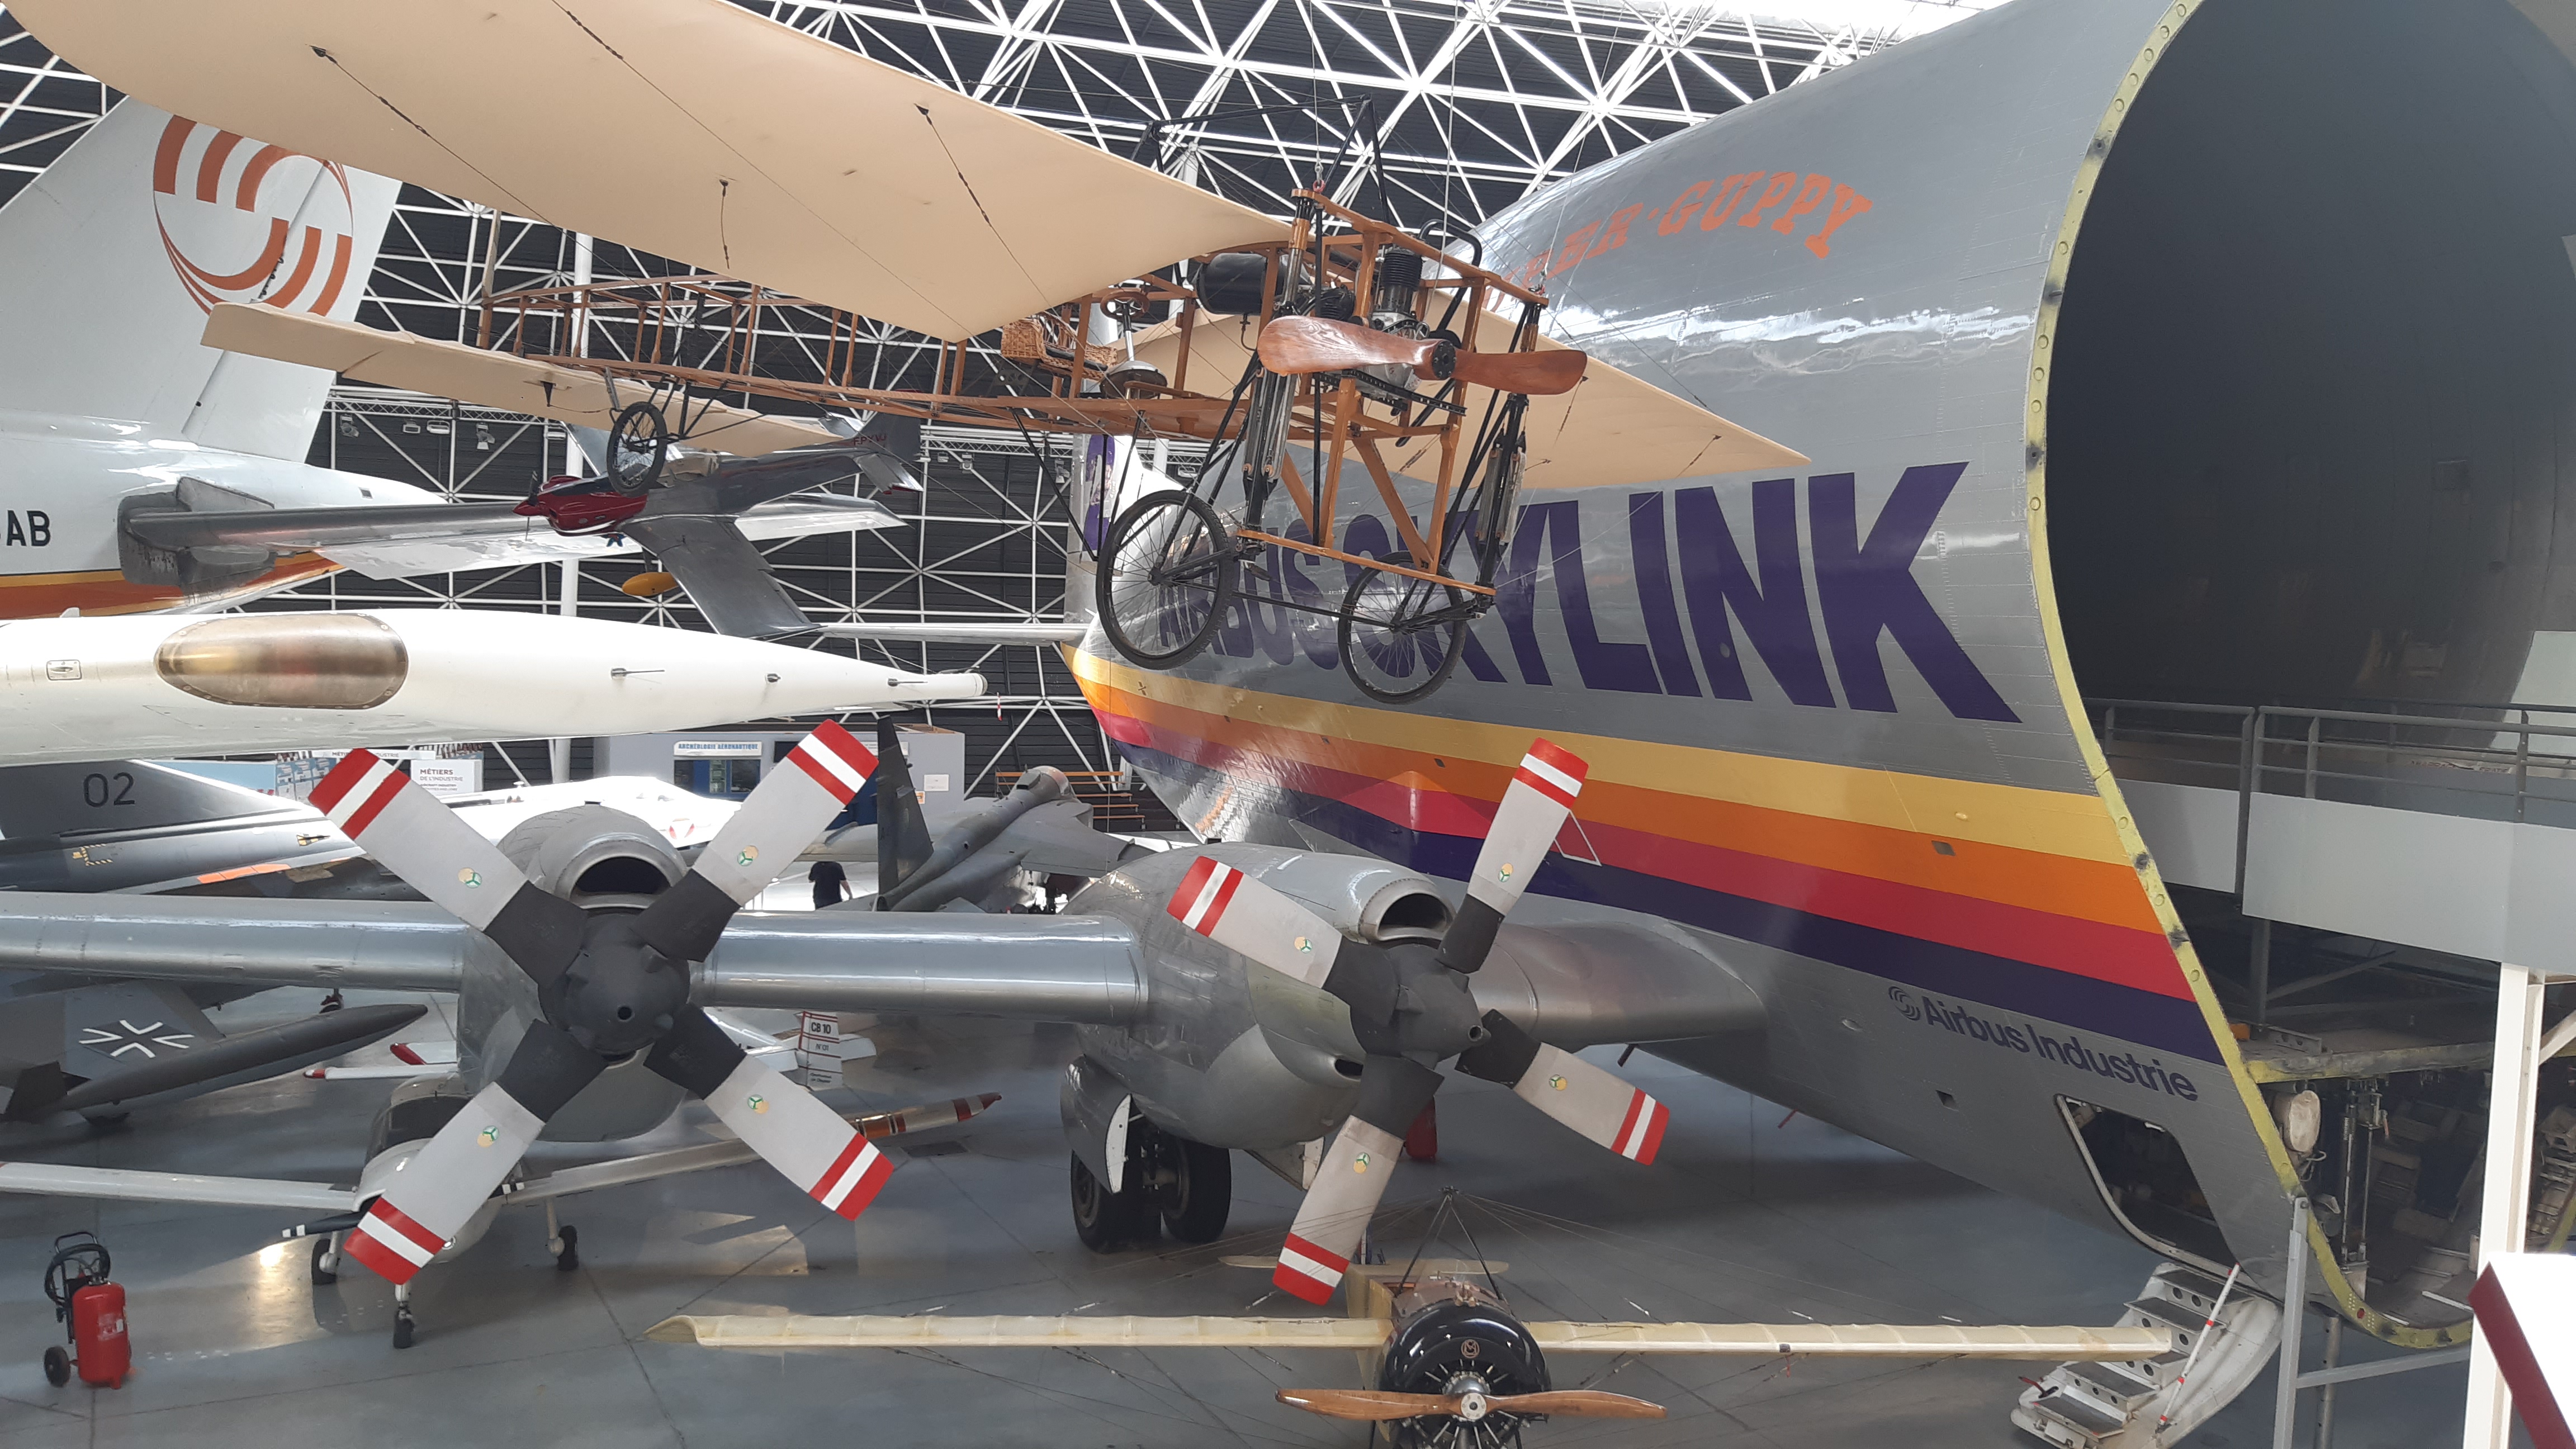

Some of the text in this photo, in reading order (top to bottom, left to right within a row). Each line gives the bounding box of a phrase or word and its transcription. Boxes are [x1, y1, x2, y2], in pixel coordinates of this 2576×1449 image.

[6, 509, 51, 547] AB
[1342, 461, 2023, 723] SKYLINK
[83, 772, 135, 808] 02
[811, 1022, 832, 1034] CB 10
[1922, 996, 2199, 1101] Airbus Industrie
